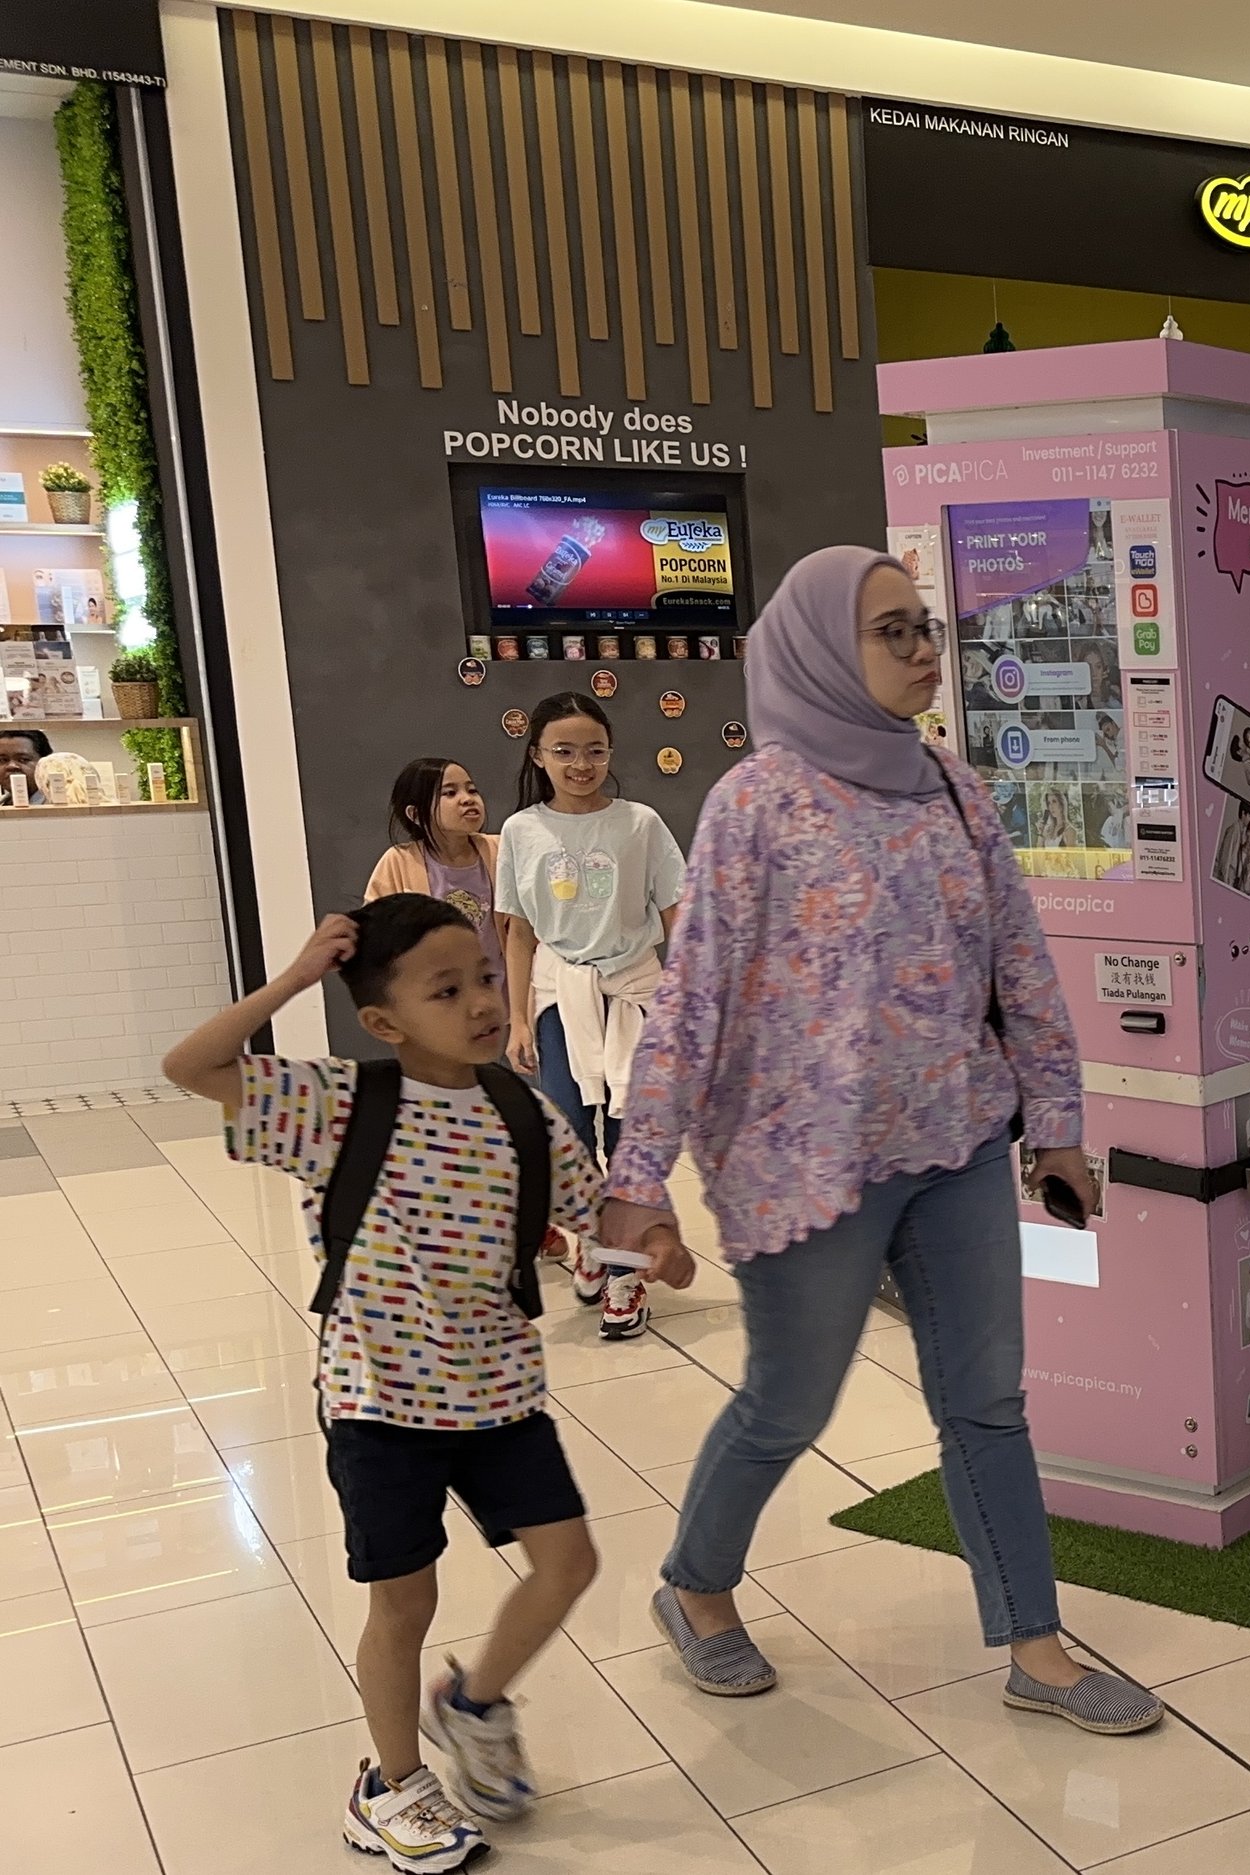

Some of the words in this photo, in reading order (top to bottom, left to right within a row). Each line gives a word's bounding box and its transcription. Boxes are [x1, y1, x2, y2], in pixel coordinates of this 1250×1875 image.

[40, 62, 69, 76] SDN.
[72, 66, 99, 80] BHD.
[102, 70, 167, 88] (1543443-T)
[870, 107, 920, 128] KEDAI
[925, 114, 1004, 139] MAKANAN
[1008, 126, 1069, 148] RINGAN
[497, 399, 614, 435] Nobody
[623, 407, 693, 434] does
[443, 430, 604, 462] POPCORN
[614, 438, 682, 465] LIKE
[690, 442, 731, 468] US
[739, 445, 747, 468] !
[1022, 444, 1094, 462] Investment
[1104, 440, 1157, 458] Support
[915, 459, 1009, 485] PICAPICA
[1052, 464, 1116, 483] 011-1147
[1121, 462, 1159, 480] 6232
[666, 520, 722, 542] Eureka
[966, 533, 1005, 549] PRINT
[1007, 531, 1047, 548] YOUR
[659, 557, 727, 573] POPCORN
[968, 555, 1025, 574] PHOTOS
[661, 574, 680, 584] No.1
[681, 575, 691, 584] Di
[692, 575, 728, 585] Malaysia
[1136, 628, 1157, 639] Grab
[1139, 639, 1155, 651] Pay
[1104, 955, 1119, 967] No
[1121, 956, 1160, 971] Change
[1101, 987, 1125, 998] Tiada
[1126, 989, 1166, 1002] Pulangan
